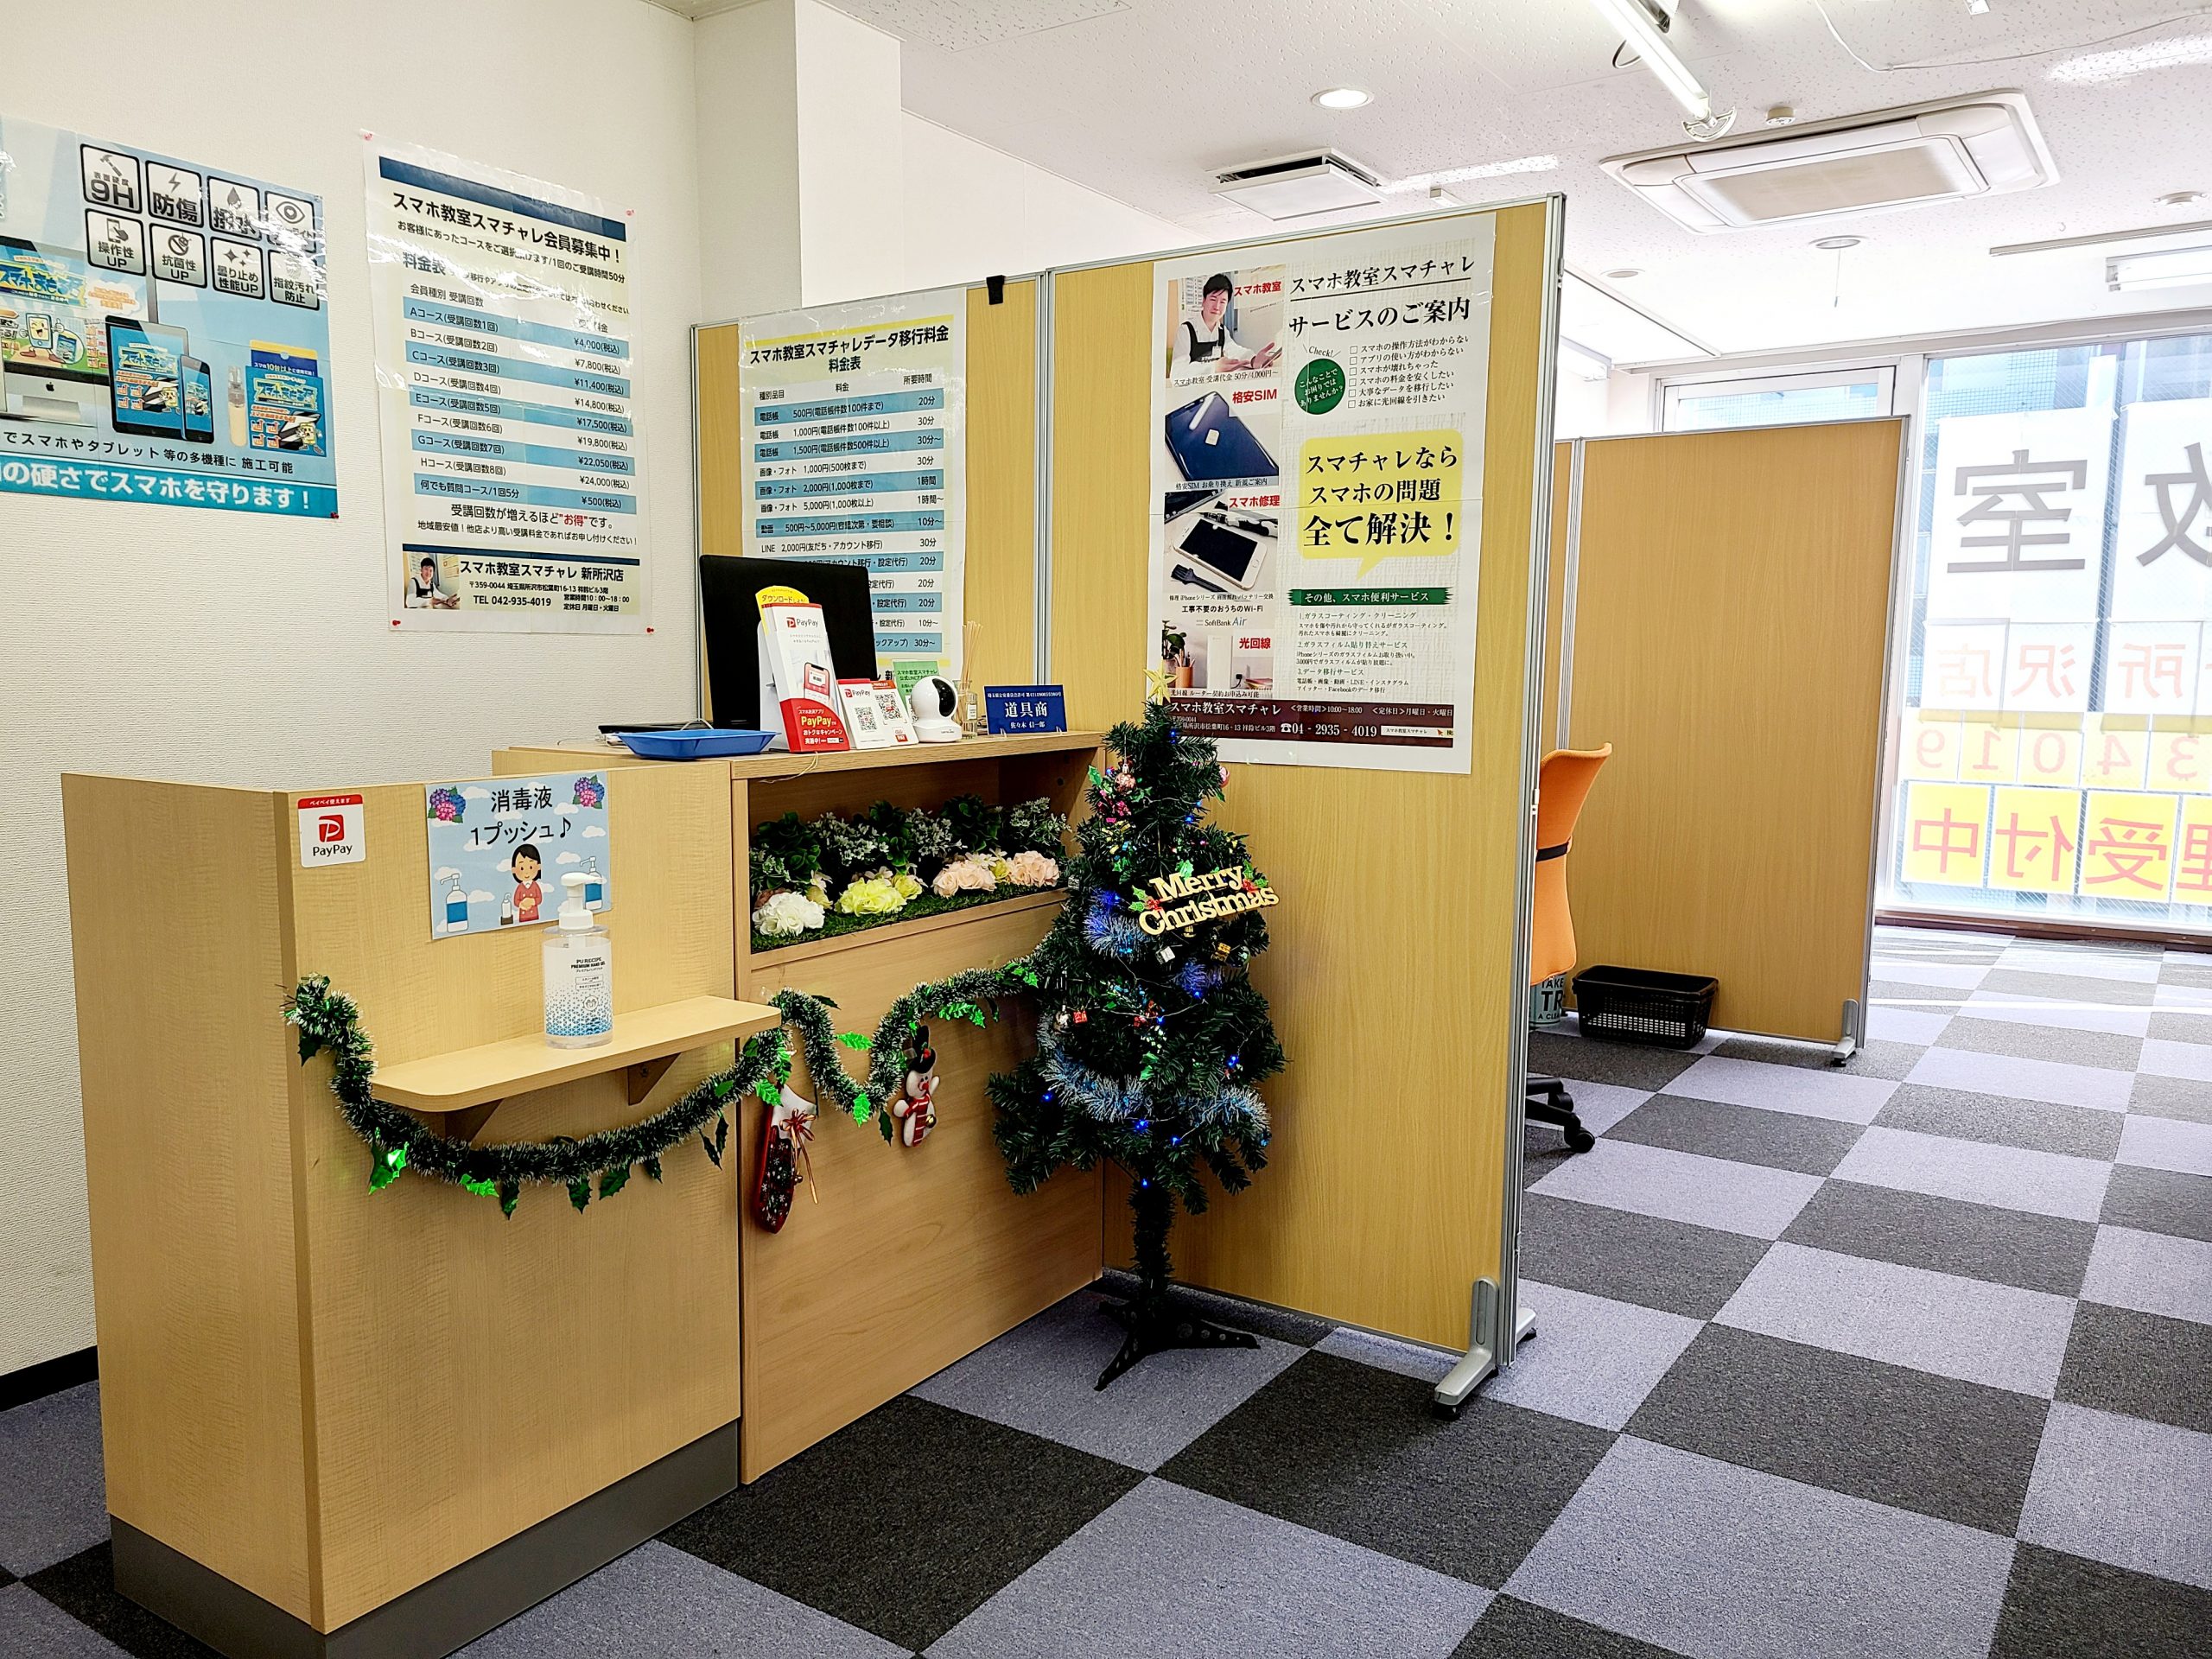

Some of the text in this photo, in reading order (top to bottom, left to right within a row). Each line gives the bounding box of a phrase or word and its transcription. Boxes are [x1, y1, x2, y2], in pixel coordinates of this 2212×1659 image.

[91, 179, 134, 209] 9H
[153, 191, 199, 223] 防傷
[98, 240, 134, 260] 操作性
[107, 257, 127, 269] UP
[162, 254, 197, 271] 抗菌性
[403, 251, 447, 276] 料金表
[171, 269, 189, 281] UP
[1290, 256, 1475, 295] スマホ教室スマチャレ
[219, 277, 259, 294] 性能UP
[274, 276, 315, 294] 指紋汚れ
[1234, 281, 1281, 297] スマホ教室
[285, 291, 306, 304] 防止
[410, 283, 485, 308] 会員種別 受講回数
[1288, 296, 1471, 338] サービスのご案内
[1308, 346, 1334, 358] Check!
[828, 355, 861, 373] 料金表
[835, 382, 849, 393] 料金
[903, 372, 932, 385] 所要時間
[918, 395, 936, 407] 20分
[1232, 389, 1278, 404] 格安SIM
[918, 415, 935, 427] 30分
[917, 454, 935, 467] 30分
[1306, 445, 1458, 474] スマチャレなら
[0, 460, 310, 510] の硬さでスマホを守ります！
[917, 475, 937, 486] 1時間
[1309, 478, 1441, 505] スマホの問題
[1229, 495, 1281, 508] スマホ修理
[1303, 511, 1453, 547] 全て解決！
[761, 543, 776, 553] LINE
[919, 537, 937, 549] 30分
[919, 556, 937, 567] 20分
[460, 561, 625, 582] スマホ教室スマチャレ 新所沢店
[918, 578, 935, 588] 20分
[473, 595, 552, 607] TEL 042-935-4019
[918, 598, 935, 608] 20分
[796, 618, 818, 628] PayPay
[1232, 616, 1248, 626] Air
[1239, 638, 1271, 650] 光回線
[1004, 701, 1047, 718] 道具商
[801, 715, 832, 728] PayPay
[1292, 722, 1377, 737] 04 2935 4019
[490, 785, 553, 814] 消毒液
[313, 843, 353, 858] PayPay
[1148, 865, 1243, 902] Merry
[1138, 887, 1280, 936] Christmas
